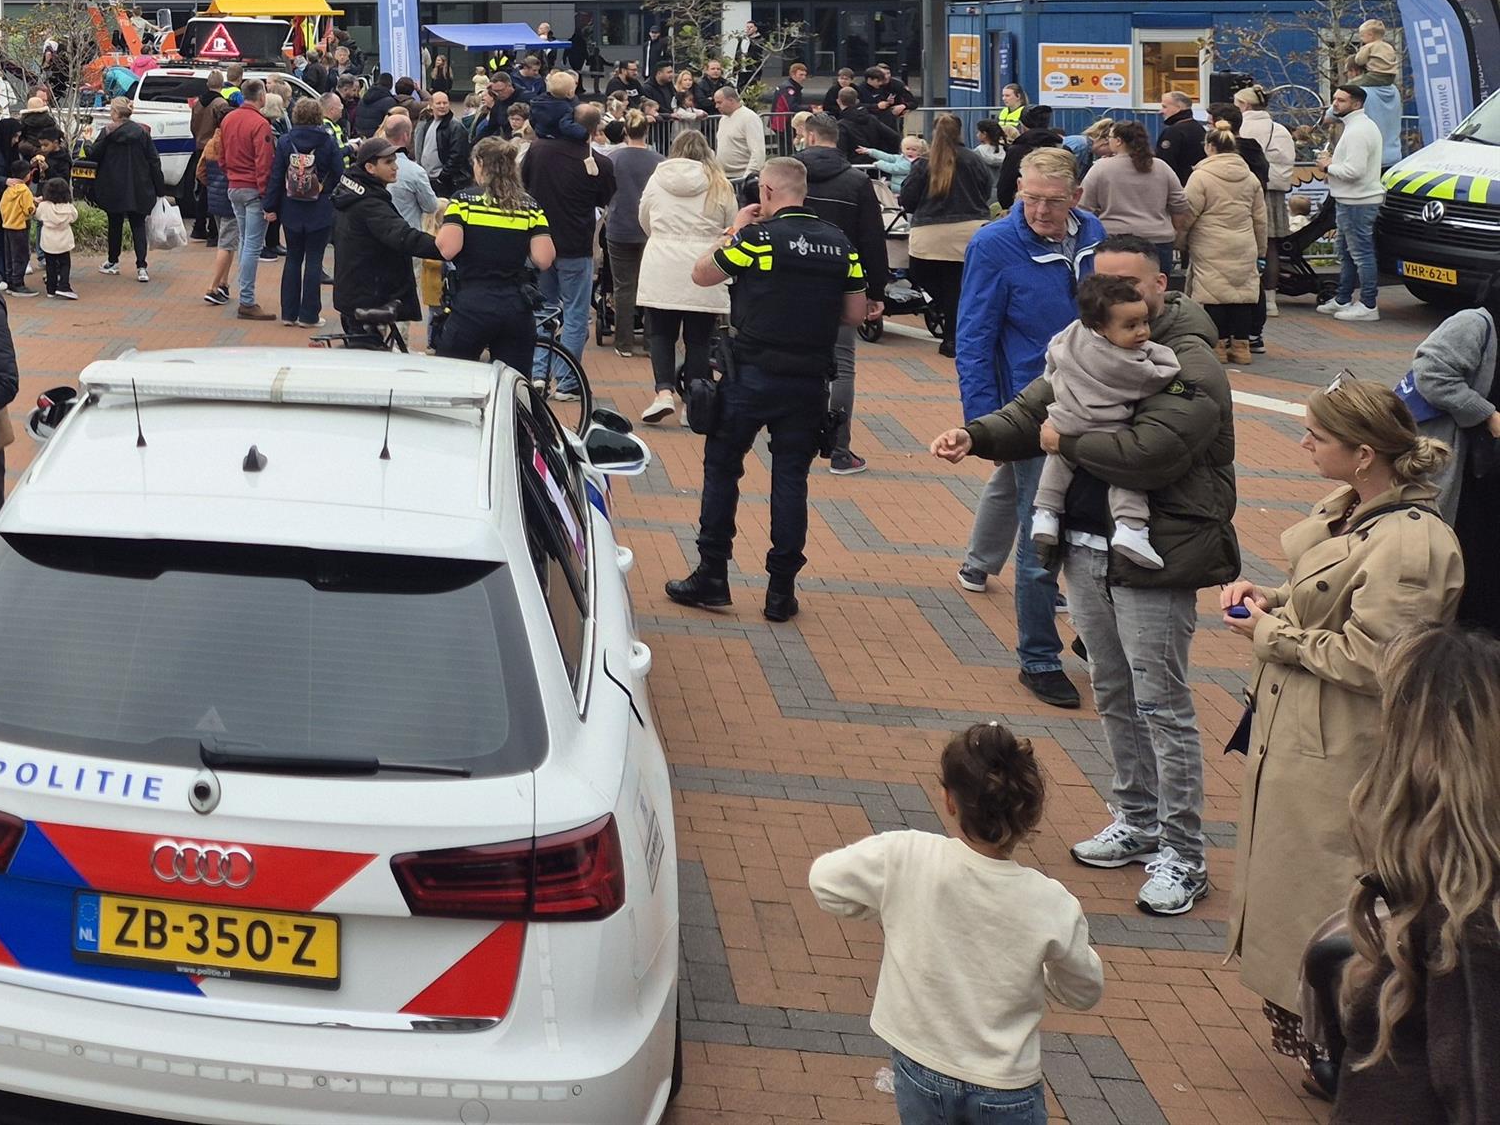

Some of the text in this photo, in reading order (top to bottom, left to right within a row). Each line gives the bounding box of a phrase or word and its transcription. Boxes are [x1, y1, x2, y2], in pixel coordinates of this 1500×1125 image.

[1405, 264, 1453, 282] VHR-62-L
[78, 926, 97, 943] NL
[115, 905, 318, 968] ZB-350-Z
[176, 965, 231, 979] www.politie.nl
